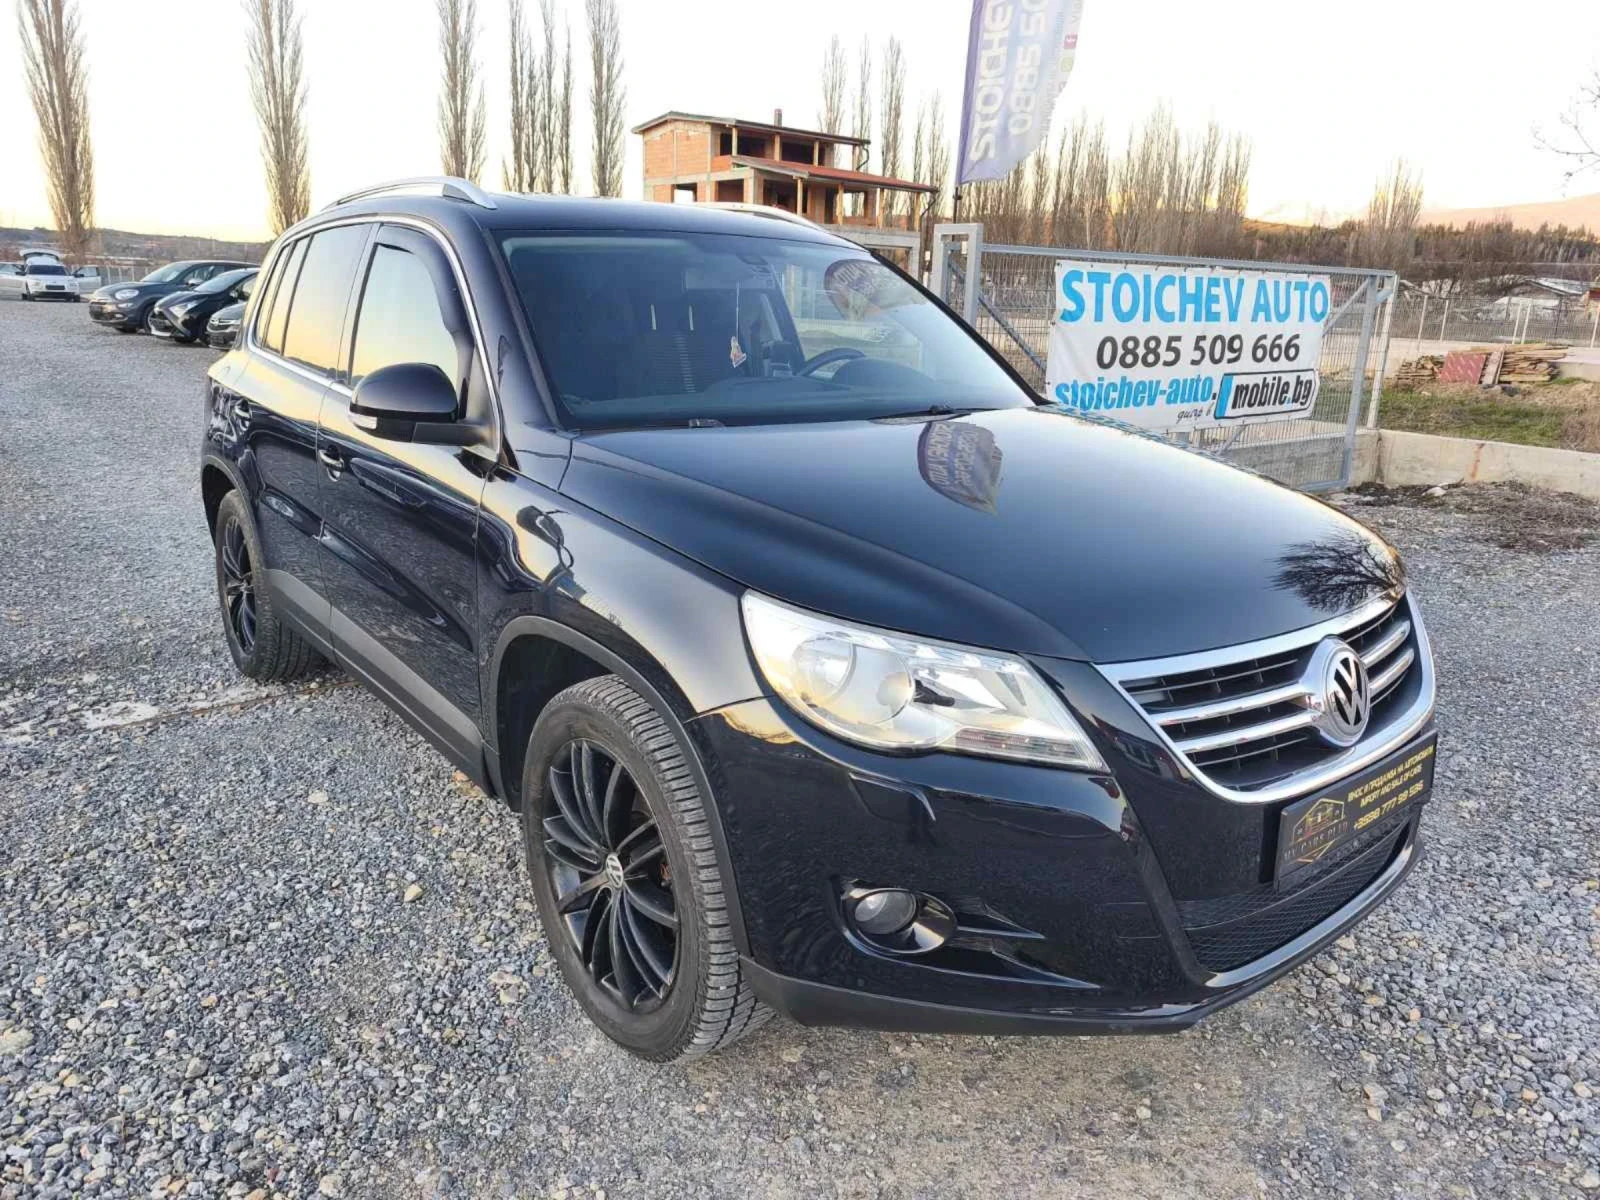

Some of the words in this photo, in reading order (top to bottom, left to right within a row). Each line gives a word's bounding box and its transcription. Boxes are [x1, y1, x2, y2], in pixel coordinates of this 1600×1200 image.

[969, 0, 1014, 161] STOICHE
[1060, 269, 1245, 324] STOICHEV
[1250, 279, 1330, 324] AUTO
[1096, 335, 1183, 370] 0885
[1190, 334, 1244, 366] 509
[1251, 333, 1301, 363] 666
[1231, 374, 1313, 410] mobile.bg
